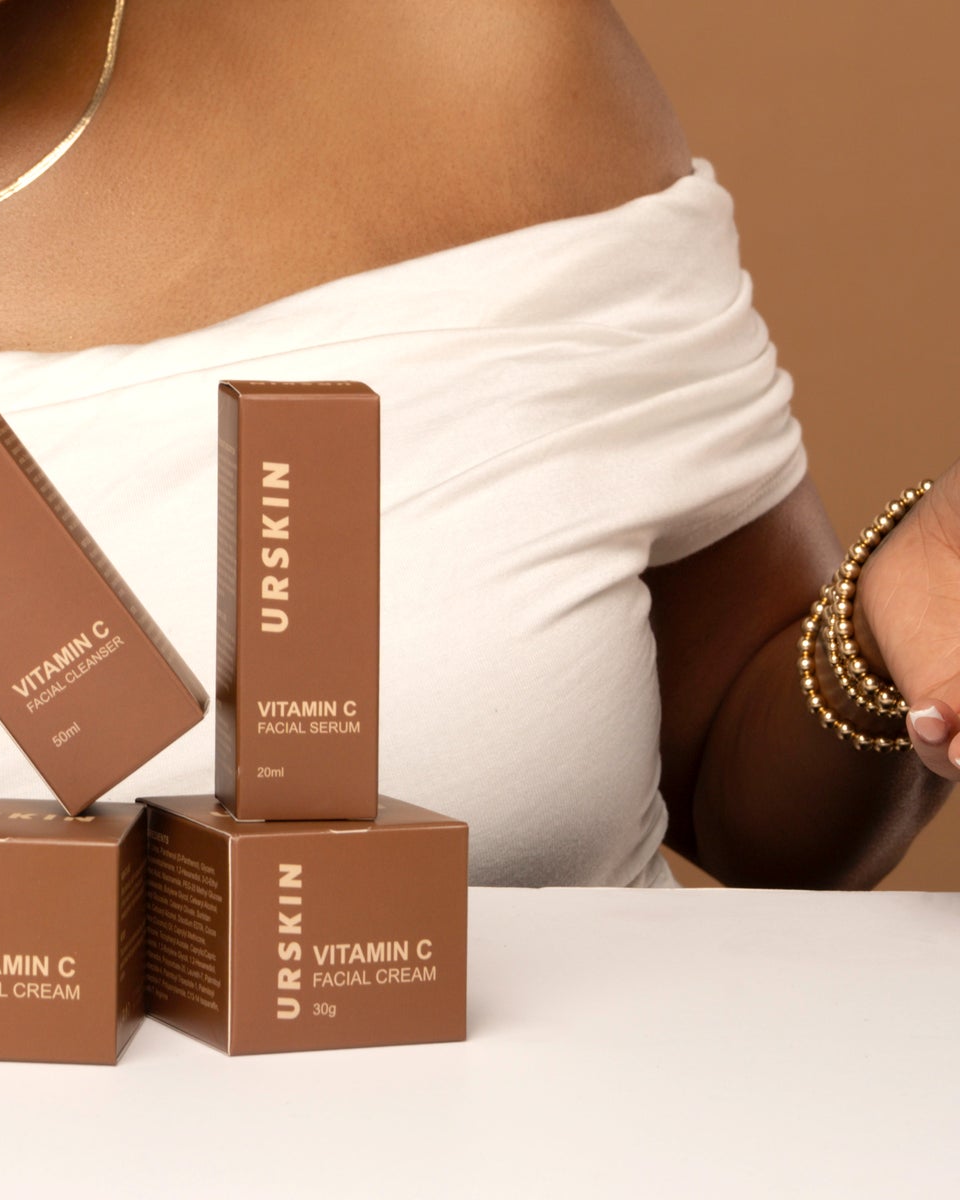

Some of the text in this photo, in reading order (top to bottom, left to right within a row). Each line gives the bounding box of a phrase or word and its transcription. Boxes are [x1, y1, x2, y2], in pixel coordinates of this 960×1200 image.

[261, 461, 291, 633] URSKIN
[11, 620, 110, 698] VITAMIN C
[26, 635, 125, 714] FACIAL CLEANSER
[257, 700, 357, 717] VITAMIN C
[52, 721, 81, 747] 50ml
[257, 721, 361, 734] FACIAL SERUM
[257, 766, 284, 778] 20ml
[277, 863, 302, 1020] URSKIN
[313, 938, 433, 966] VITAMIN C
[58, 956, 76, 978] C
[313, 966, 437, 988] FACIAL CREAM
[13, 982, 81, 1001] CREAM
[313, 1002, 337, 1018] 30g
